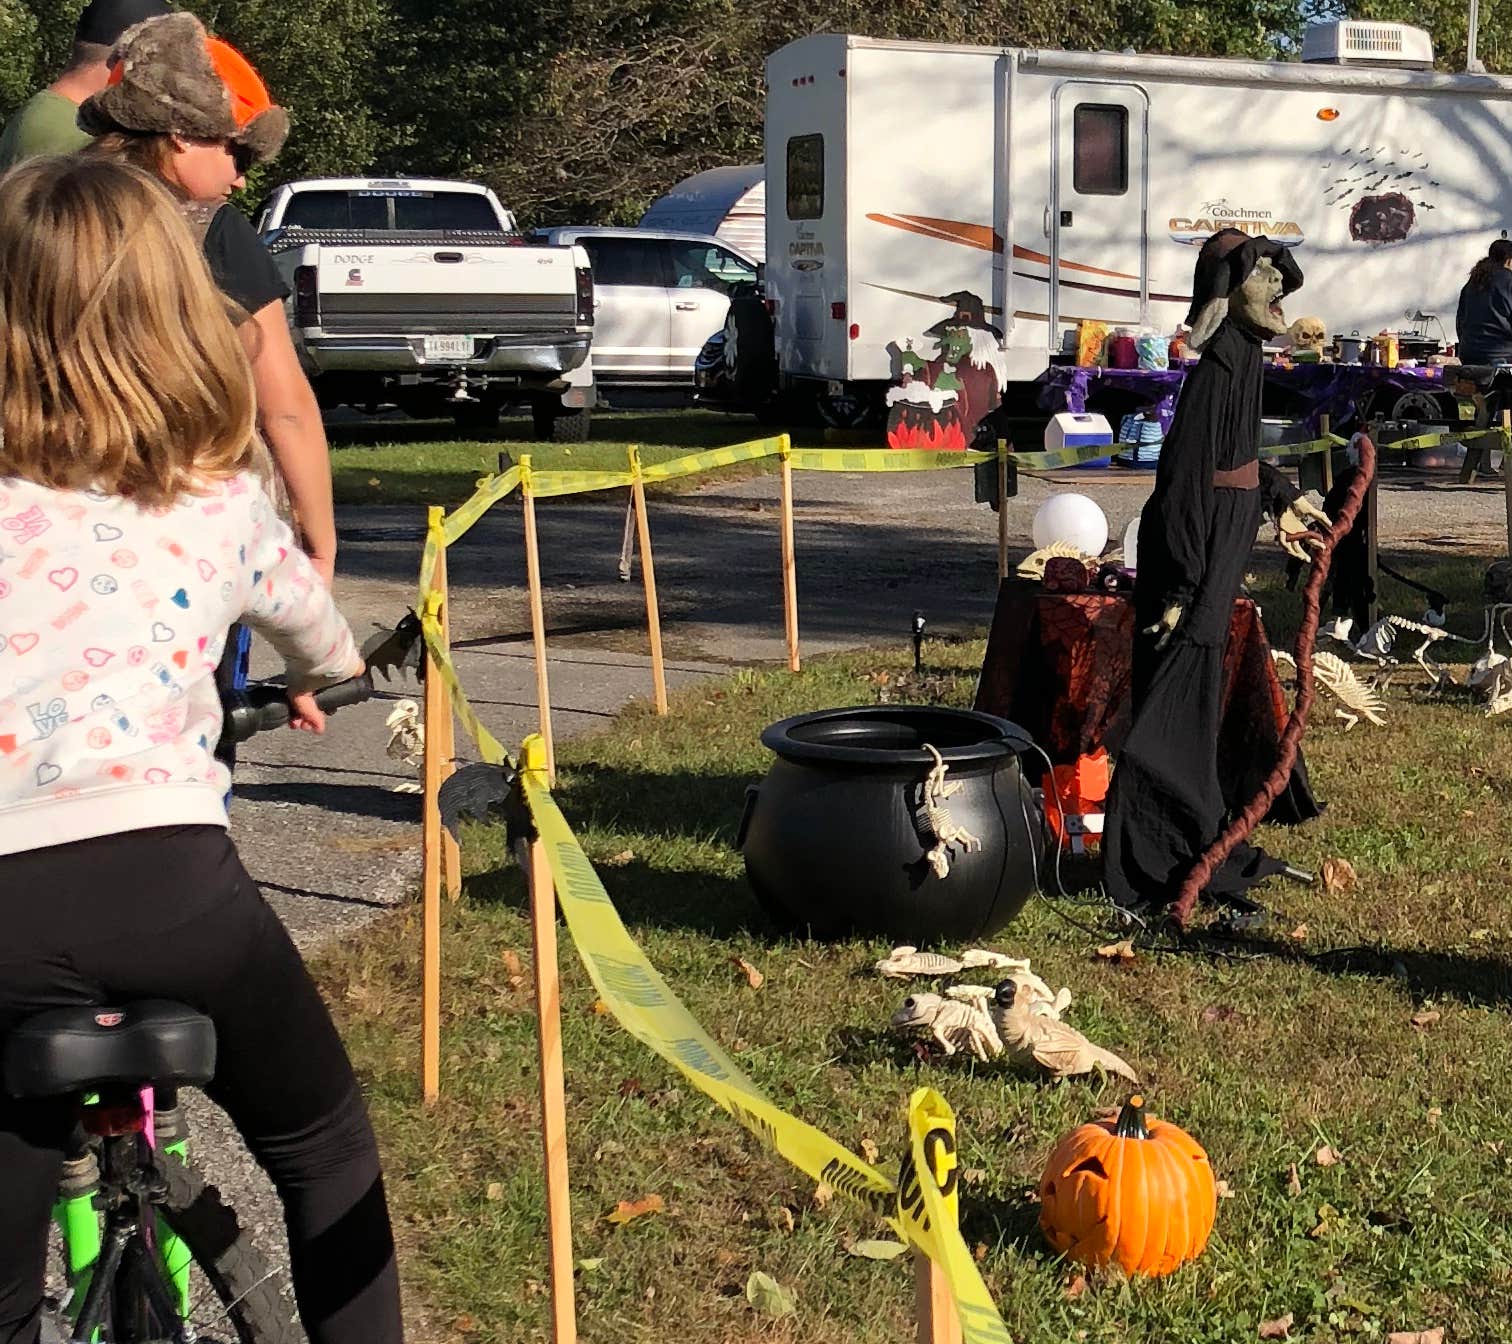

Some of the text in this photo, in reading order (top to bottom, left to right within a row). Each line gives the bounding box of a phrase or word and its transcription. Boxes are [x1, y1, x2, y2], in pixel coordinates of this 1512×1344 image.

[1211, 206, 1272, 219] Coachmen
[1168, 217, 1305, 236] CAPTIVA
[334, 254, 375, 264] DODGE
